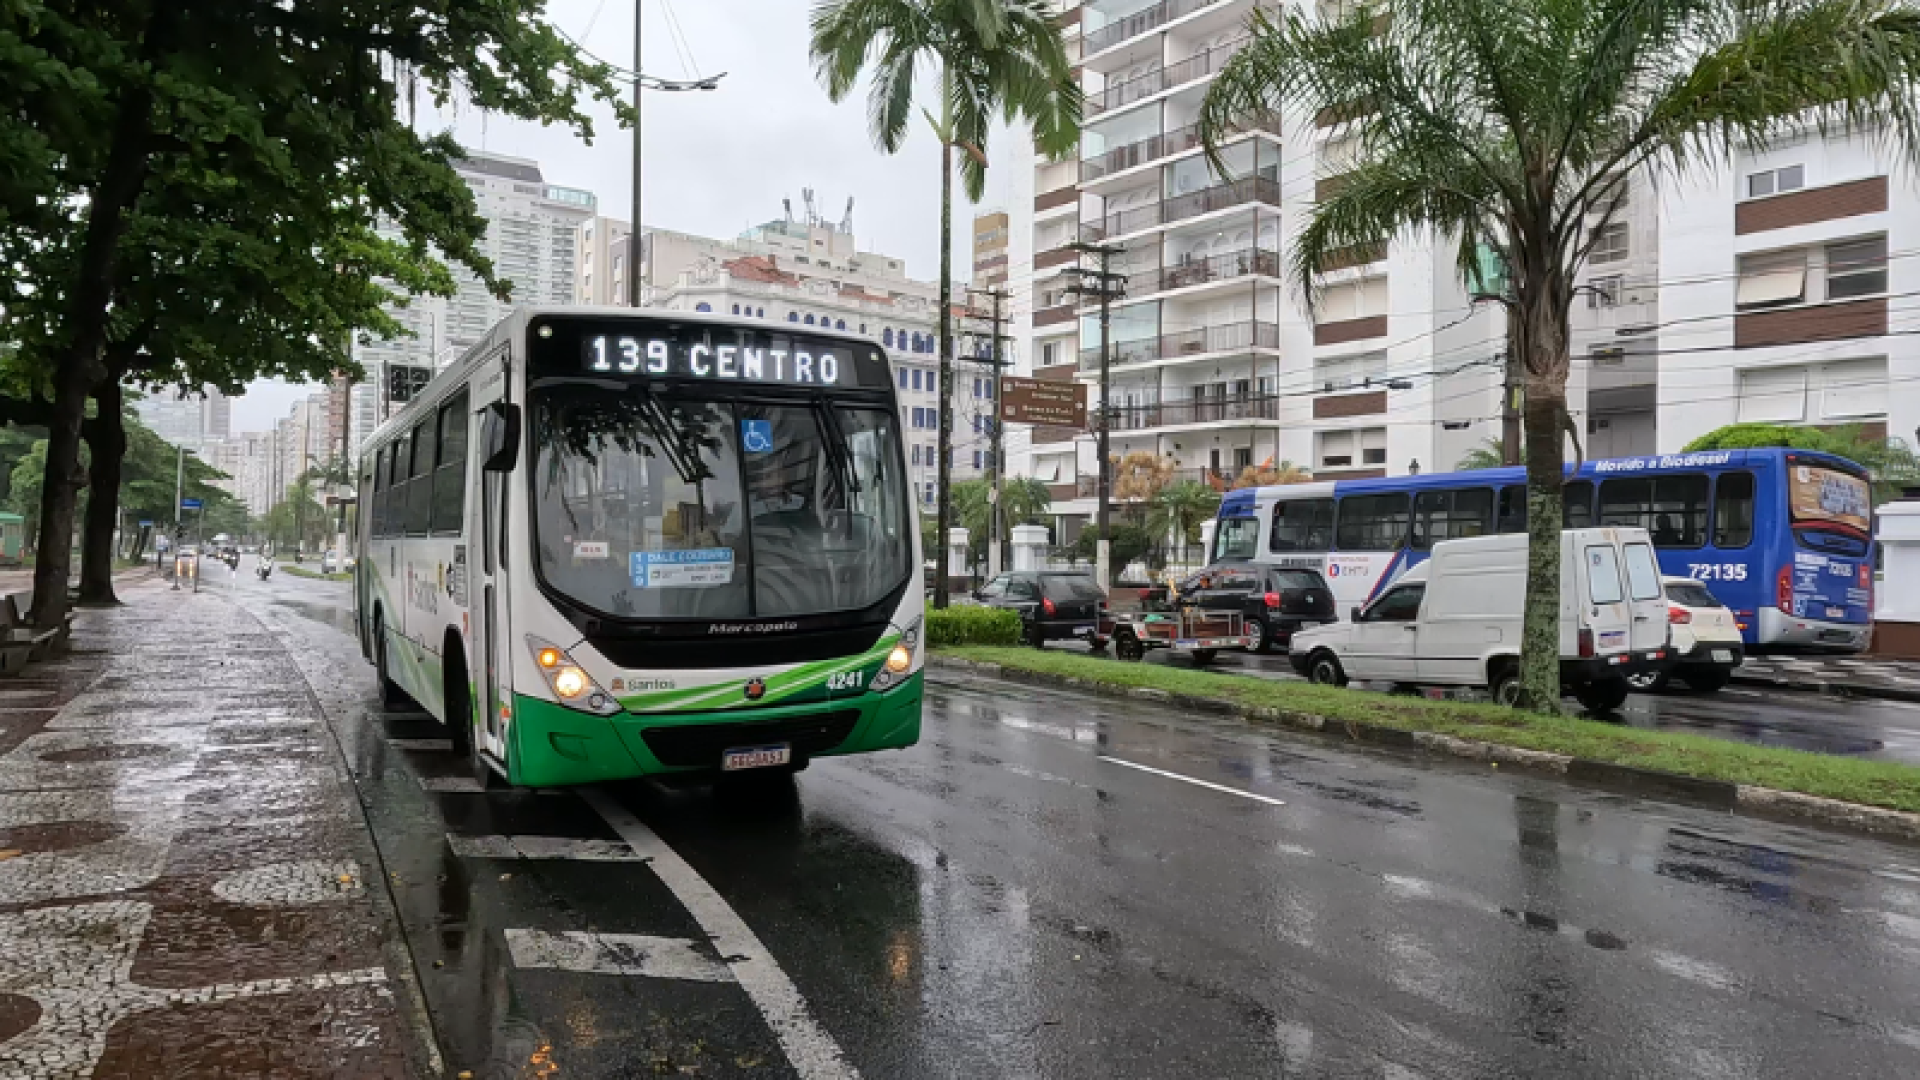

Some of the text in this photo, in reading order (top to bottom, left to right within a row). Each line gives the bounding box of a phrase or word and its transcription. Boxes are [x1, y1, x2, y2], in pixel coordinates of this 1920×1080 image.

[592, 335, 839, 384] 139 CENTRO
[1595, 458, 1645, 472] Movido
[1660, 451, 1730, 468] Biodiesel
[1687, 563, 1748, 581] 72135
[707, 620, 798, 635] Marcopolo
[627, 678, 675, 691] Santos
[827, 670, 863, 690] 4241
